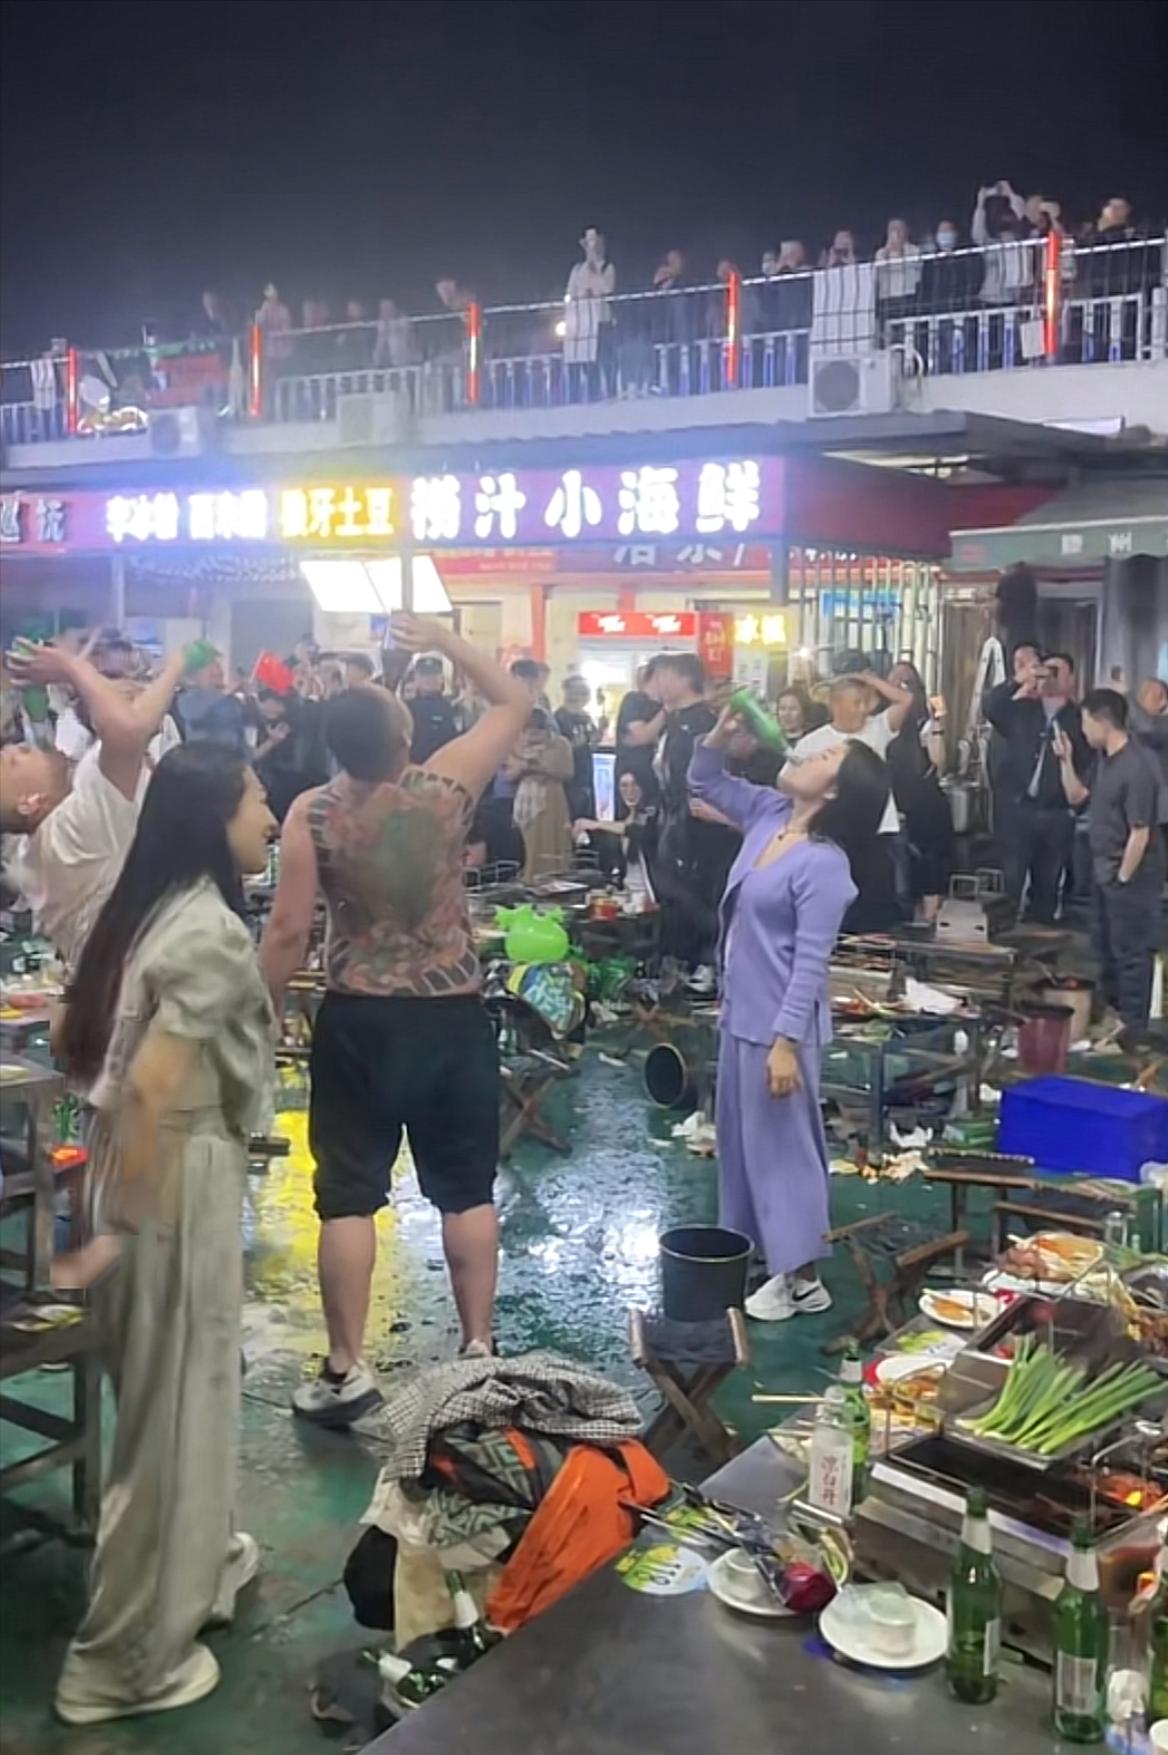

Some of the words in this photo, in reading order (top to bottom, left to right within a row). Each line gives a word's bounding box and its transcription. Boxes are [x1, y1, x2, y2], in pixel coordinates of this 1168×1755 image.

[410, 460, 761, 541] 捞汁小海鲜
